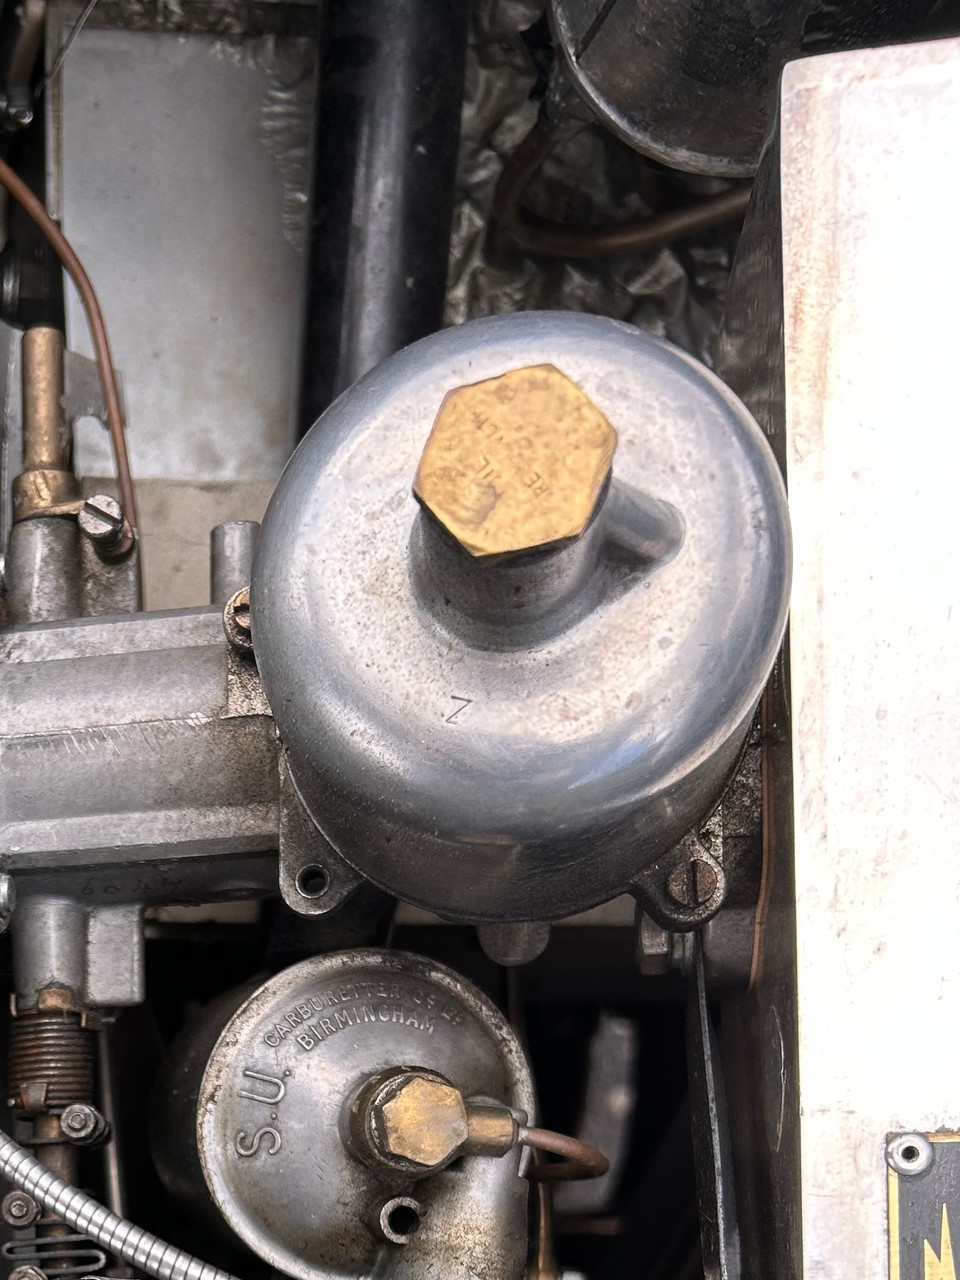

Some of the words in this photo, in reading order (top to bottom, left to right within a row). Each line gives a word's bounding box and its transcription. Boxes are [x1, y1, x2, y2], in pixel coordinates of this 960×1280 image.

[263, 982, 401, 1048] CARBURETTER
[296, 1003, 437, 1052] BIRMINGHAM
[237, 1068, 292, 1157] S.U.
